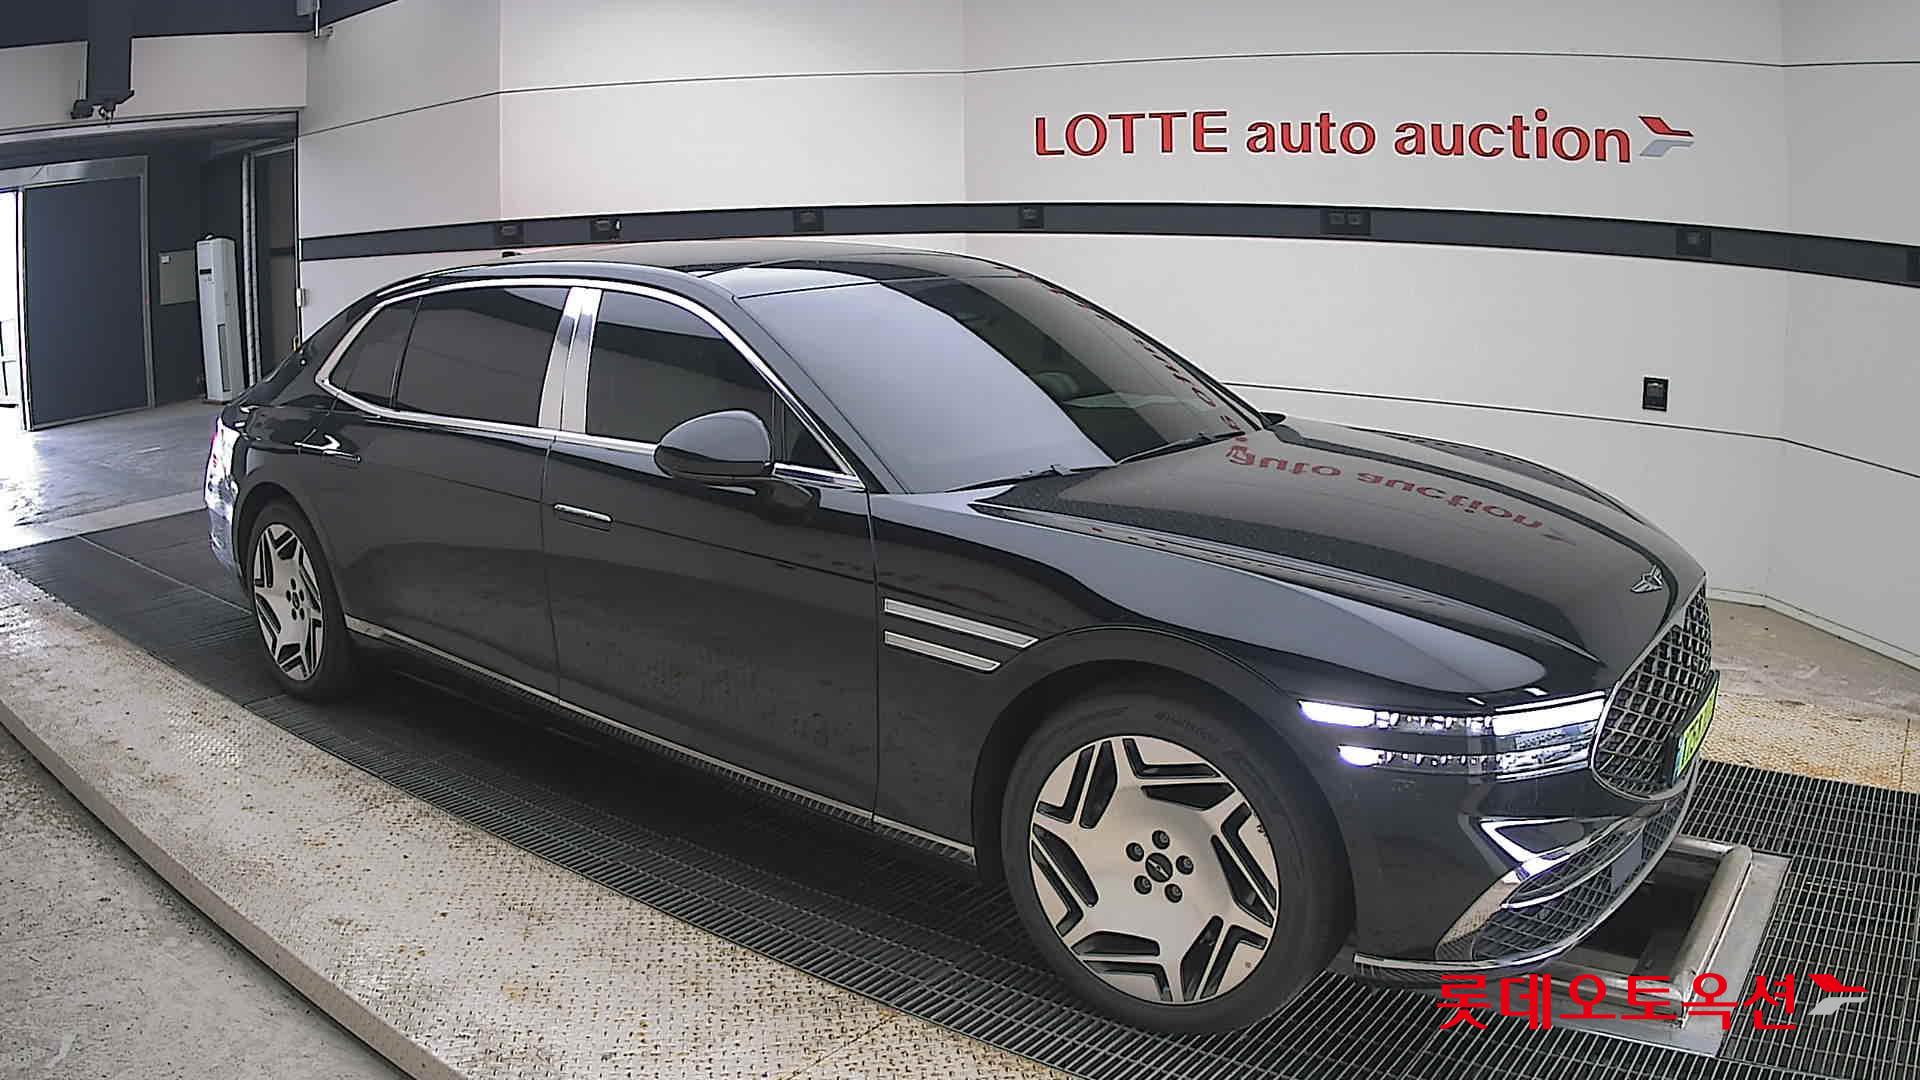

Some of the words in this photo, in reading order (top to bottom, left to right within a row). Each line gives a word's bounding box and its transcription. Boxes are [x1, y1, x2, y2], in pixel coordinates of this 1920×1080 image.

[1035, 111, 1228, 156] LOTTE
[1246, 112, 1377, 154] auto
[1393, 107, 1631, 163] auction
